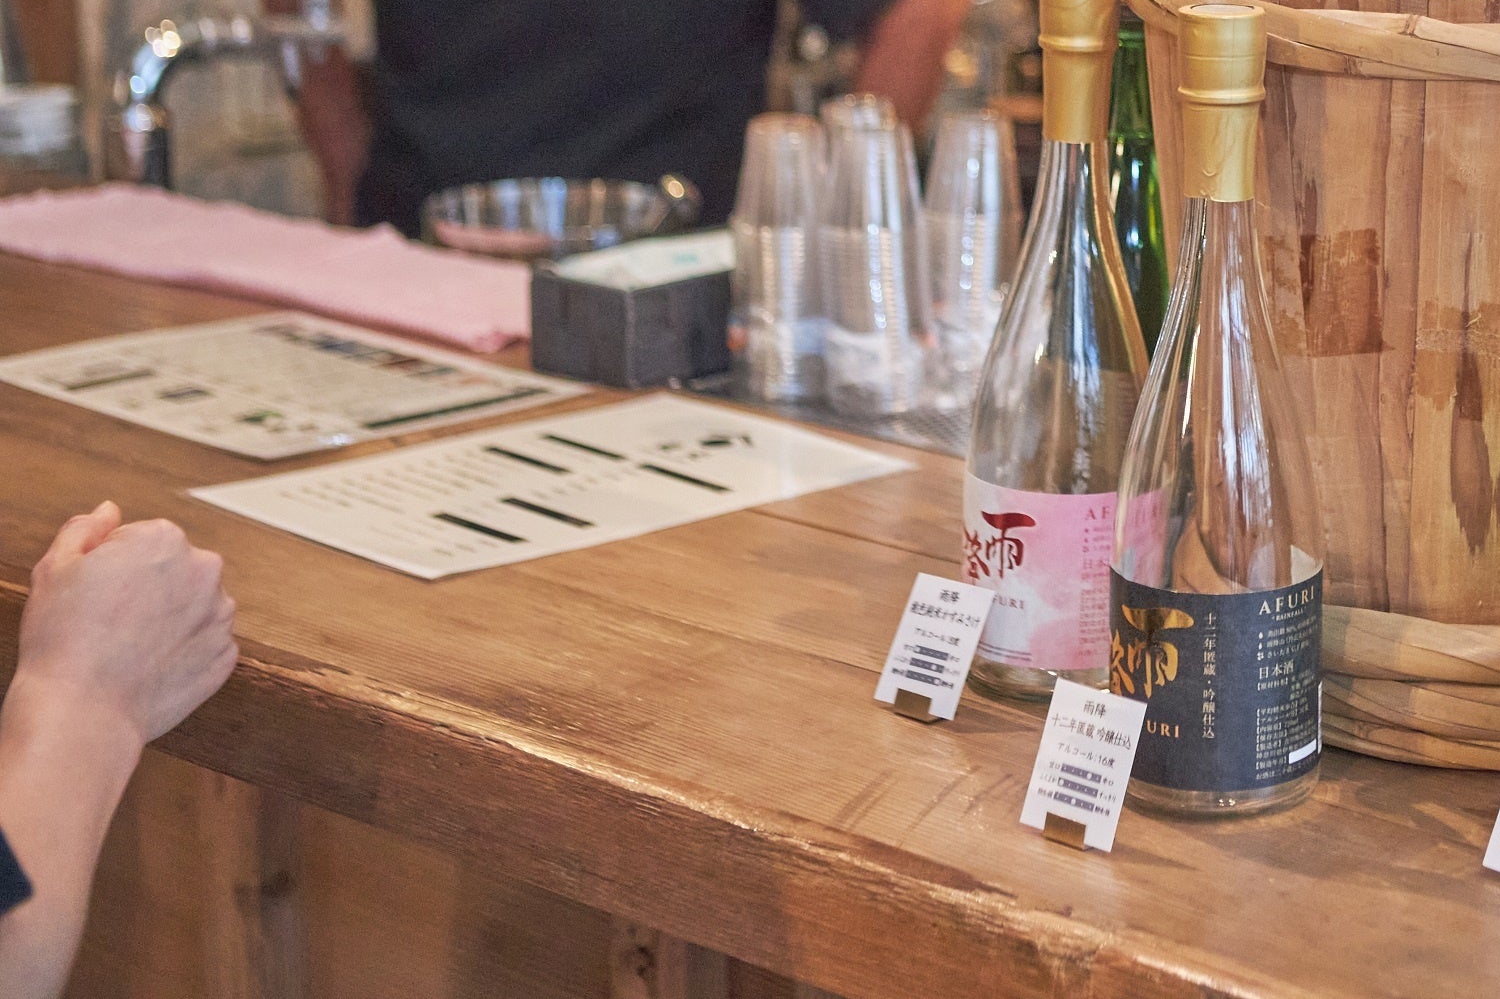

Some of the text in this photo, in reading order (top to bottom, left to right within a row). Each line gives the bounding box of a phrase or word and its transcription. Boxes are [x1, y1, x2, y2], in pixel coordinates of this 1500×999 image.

[992, 593, 1025, 610] FURI
[1259, 585, 1314, 615] AFURI
[1259, 659, 1294, 680] 日本酒
[1146, 720, 1180, 738] URI
